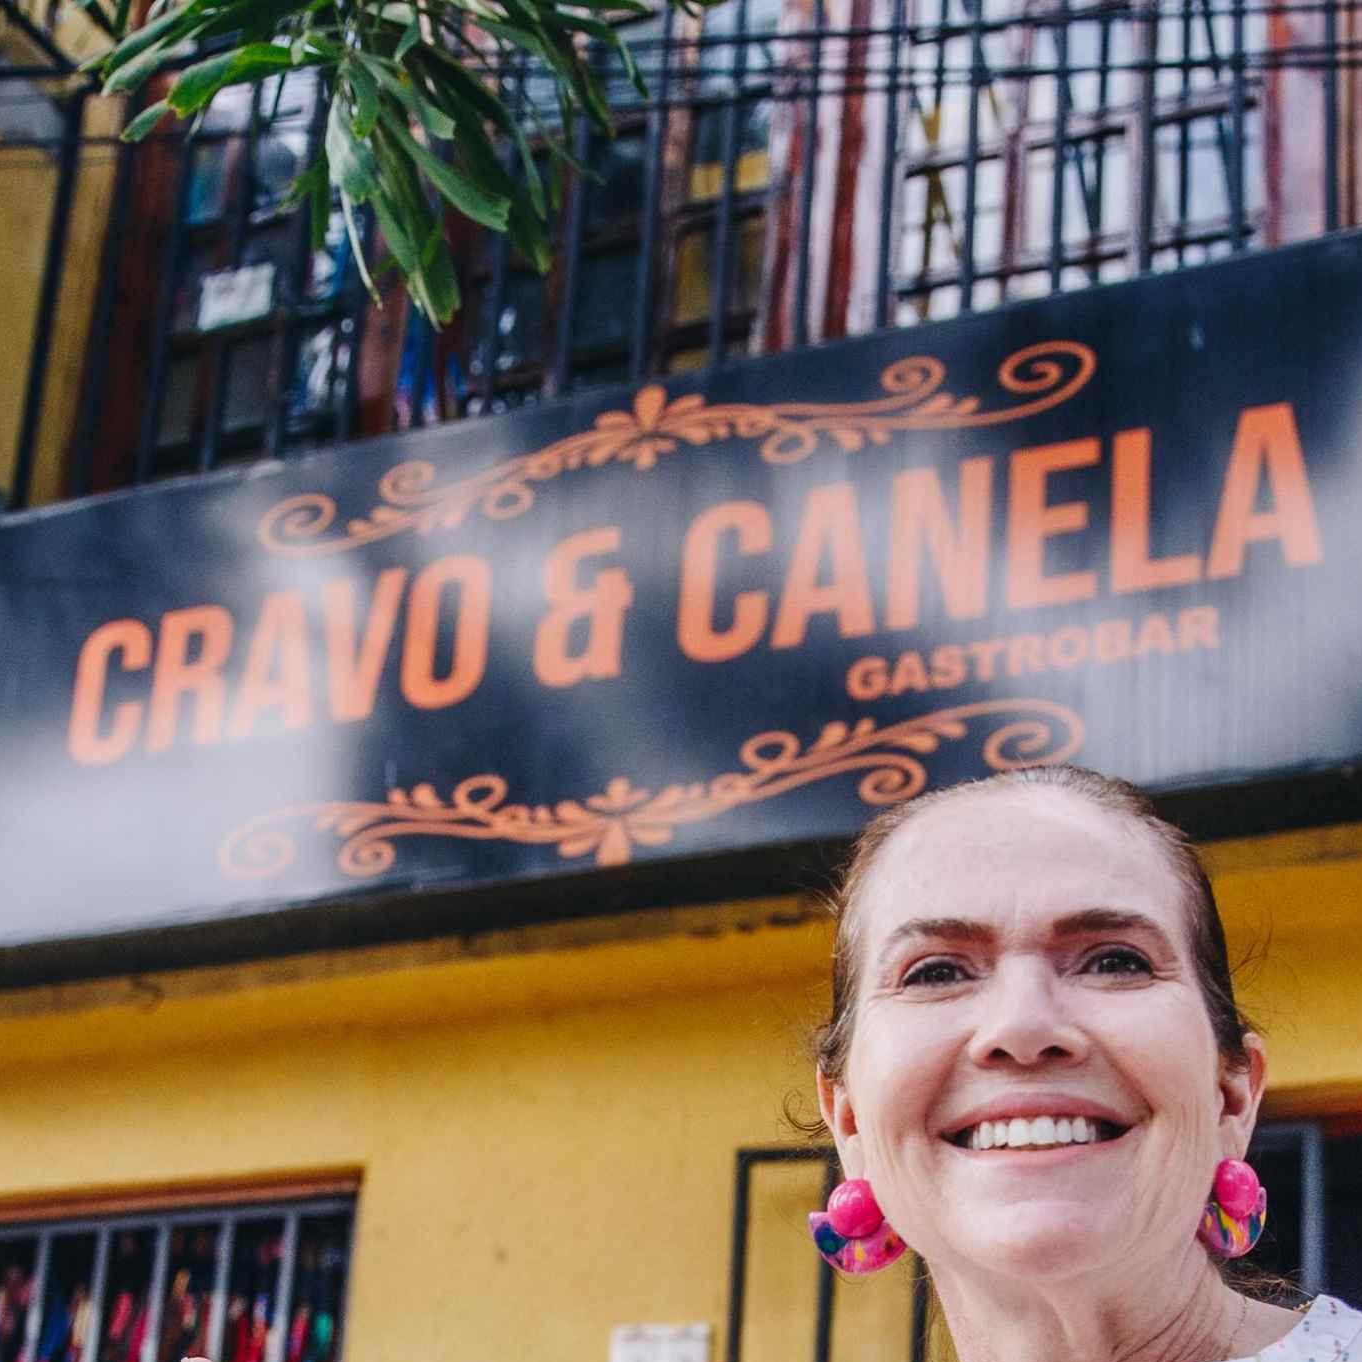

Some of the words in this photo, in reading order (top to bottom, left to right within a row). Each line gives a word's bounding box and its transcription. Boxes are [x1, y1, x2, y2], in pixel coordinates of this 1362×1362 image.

[67, 554, 494, 766] CRAVO
[533, 525, 635, 688] &
[676, 400, 1325, 664] CANELA
[845, 605, 1221, 702] GASTROBAR
